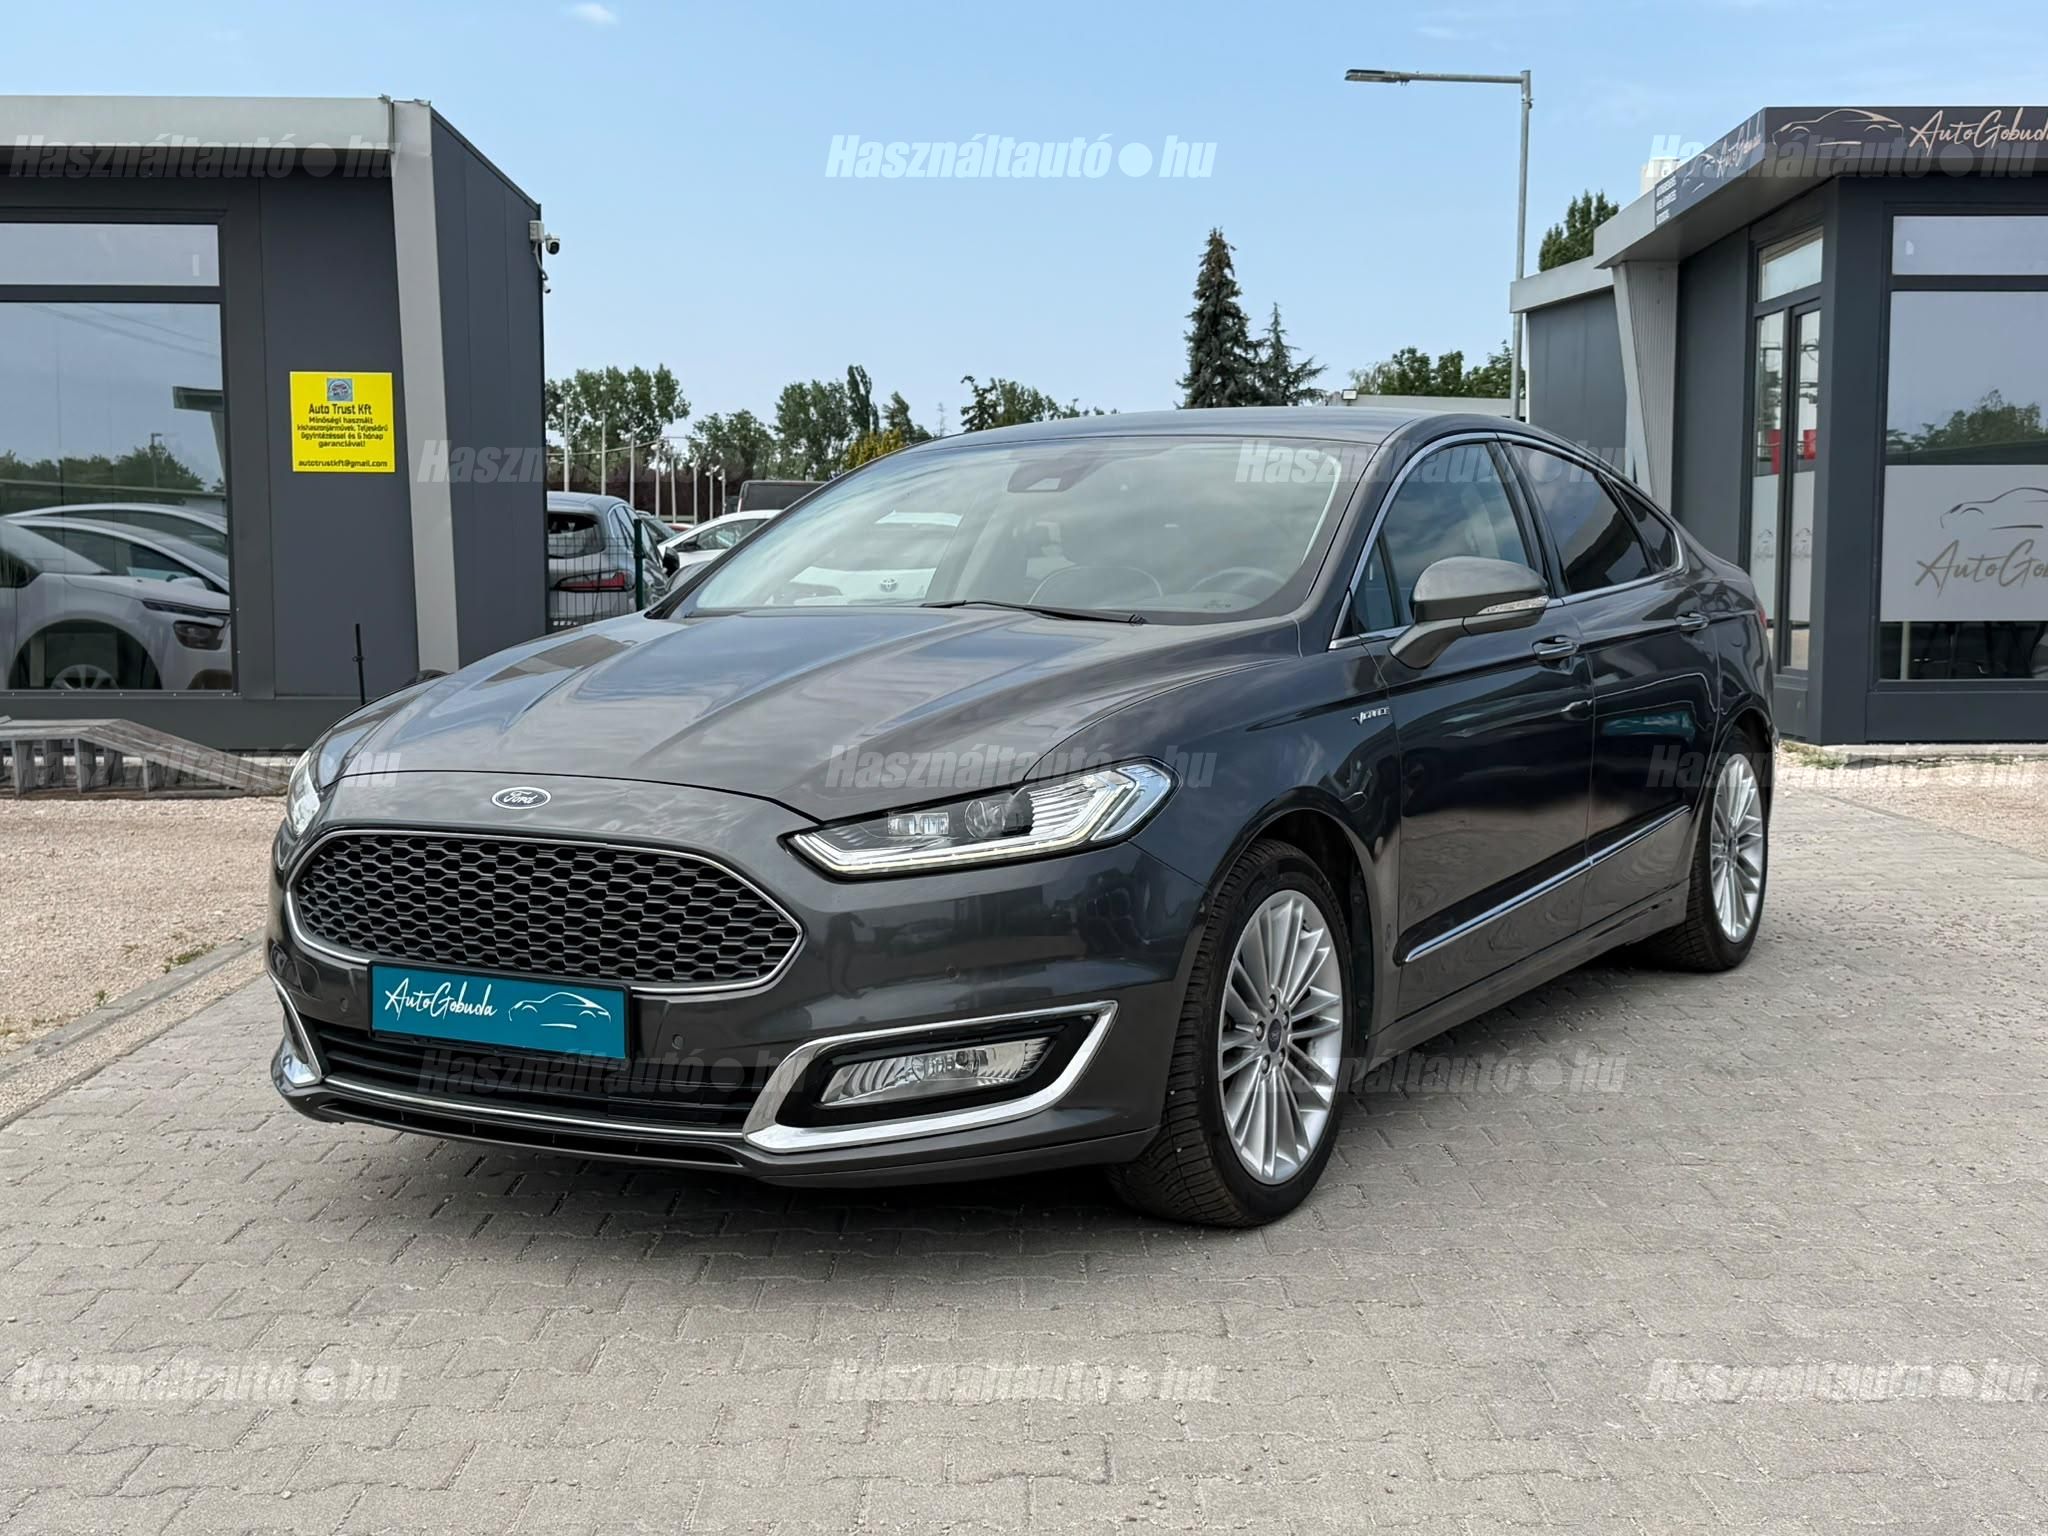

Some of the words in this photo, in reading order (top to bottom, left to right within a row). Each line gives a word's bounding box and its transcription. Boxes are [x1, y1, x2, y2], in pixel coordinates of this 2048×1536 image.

[308, 403, 329, 414] Auto
[332, 403, 356, 414] Trust
[358, 404, 372, 414] Kft
[1915, 539, 2048, 599] AutoGo
[503, 791, 538, 804] Ford
[384, 977, 498, 1021] AutoGobuda
